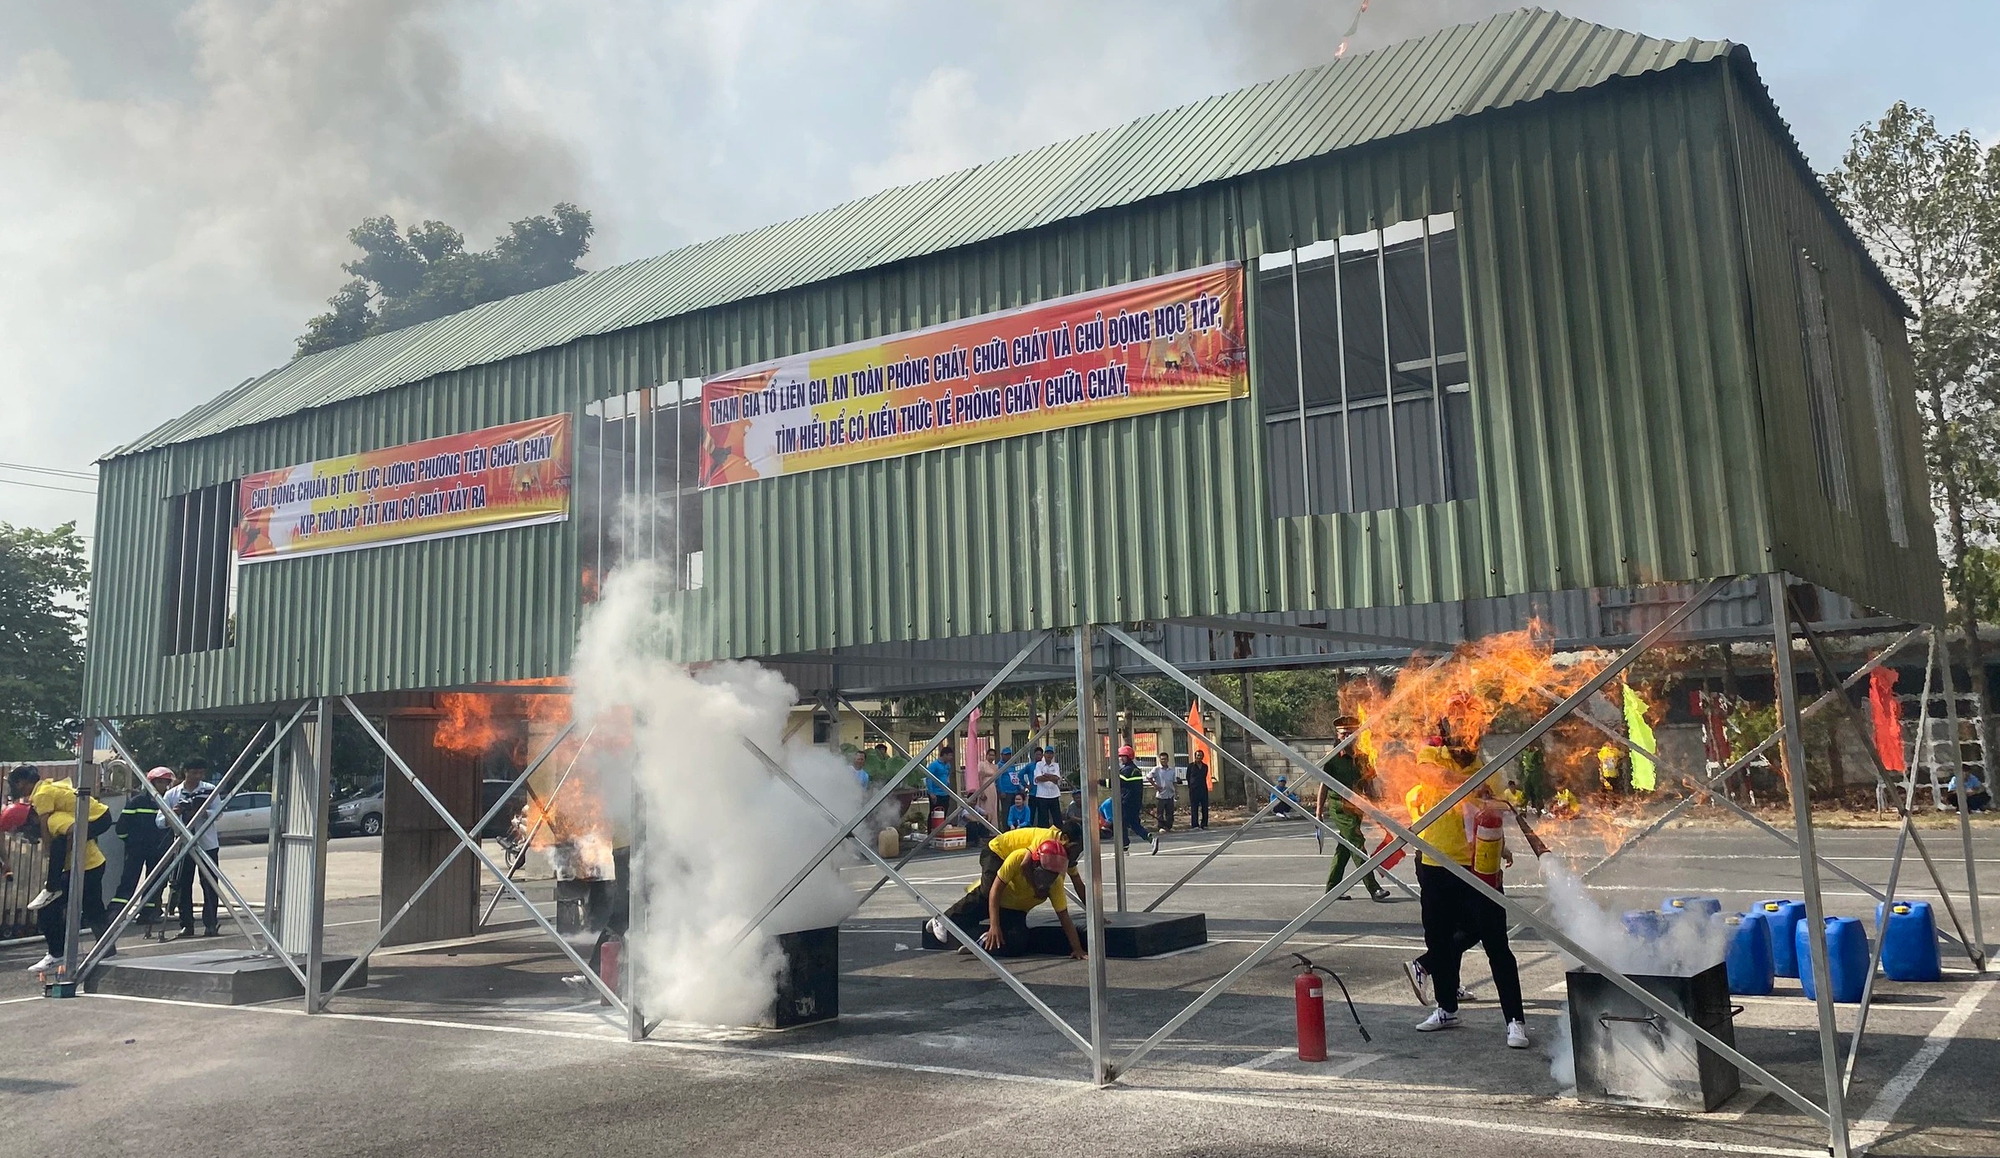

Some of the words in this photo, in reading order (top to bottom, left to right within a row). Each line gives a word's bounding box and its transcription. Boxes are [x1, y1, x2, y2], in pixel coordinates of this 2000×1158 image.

[710, 395, 739, 425] THAM
[742, 394, 760, 419] GIA
[762, 379, 777, 413] TỔ
[780, 383, 805, 410] LIÊN
[809, 380, 827, 406] GIA
[832, 374, 848, 401] AN
[851, 363, 883, 397] TOÀN
[887, 353, 930, 391] PHÒNG
[933, 344, 969, 382] CHÁY,
[972, 335, 1009, 374] CHỮA
[1012, 327, 1049, 366] CHÁY
[1052, 321, 1071, 357] VÀ
[1075, 310, 1104, 353] CHỦ
[1109, 311, 1150, 350] ĐỘNG
[1155, 302, 1186, 343] HỌC
[1189, 291, 1222, 336] TẬP,
[775, 425, 797, 454] TÌM
[799, 413, 826, 452] HIỂU
[830, 408, 845, 446] ĐỂ
[849, 415, 865, 442] CÓ
[868, 402, 898, 439] KIẾN
[900, 397, 932, 433] THỨC
[935, 389, 951, 427] VỀ
[955, 385, 1000, 424] PHÒNG
[1004, 377, 1041, 415] CHÁY
[1045, 370, 1083, 408] CHỮA
[1087, 359, 1129, 401] CHÁY,
[251, 481, 268, 509] CHỦ
[271, 481, 295, 508] ĐỘNG
[298, 470, 328, 502] CHUẨN
[331, 475, 340, 499] BỊ
[343, 465, 360, 493] TỐT
[362, 466, 379, 494] LỰC
[382, 460, 415, 489] LƯỢNG
[418, 453, 460, 480] PHƯƠNG
[464, 445, 487, 476] TIỆN
[490, 439, 519, 469] CHỮA
[523, 433, 552, 463] CHÁY
[300, 514, 315, 538] KỊP
[318, 506, 338, 532] THỜI
[341, 504, 360, 532] DẬP
[363, 496, 379, 525] TẮT
[382, 500, 399, 523] KHI
[401, 493, 415, 520] CÓ
[418, 488, 445, 518] CHÁY
[448, 482, 468, 513] XẢY
[471, 485, 486, 508] RA
